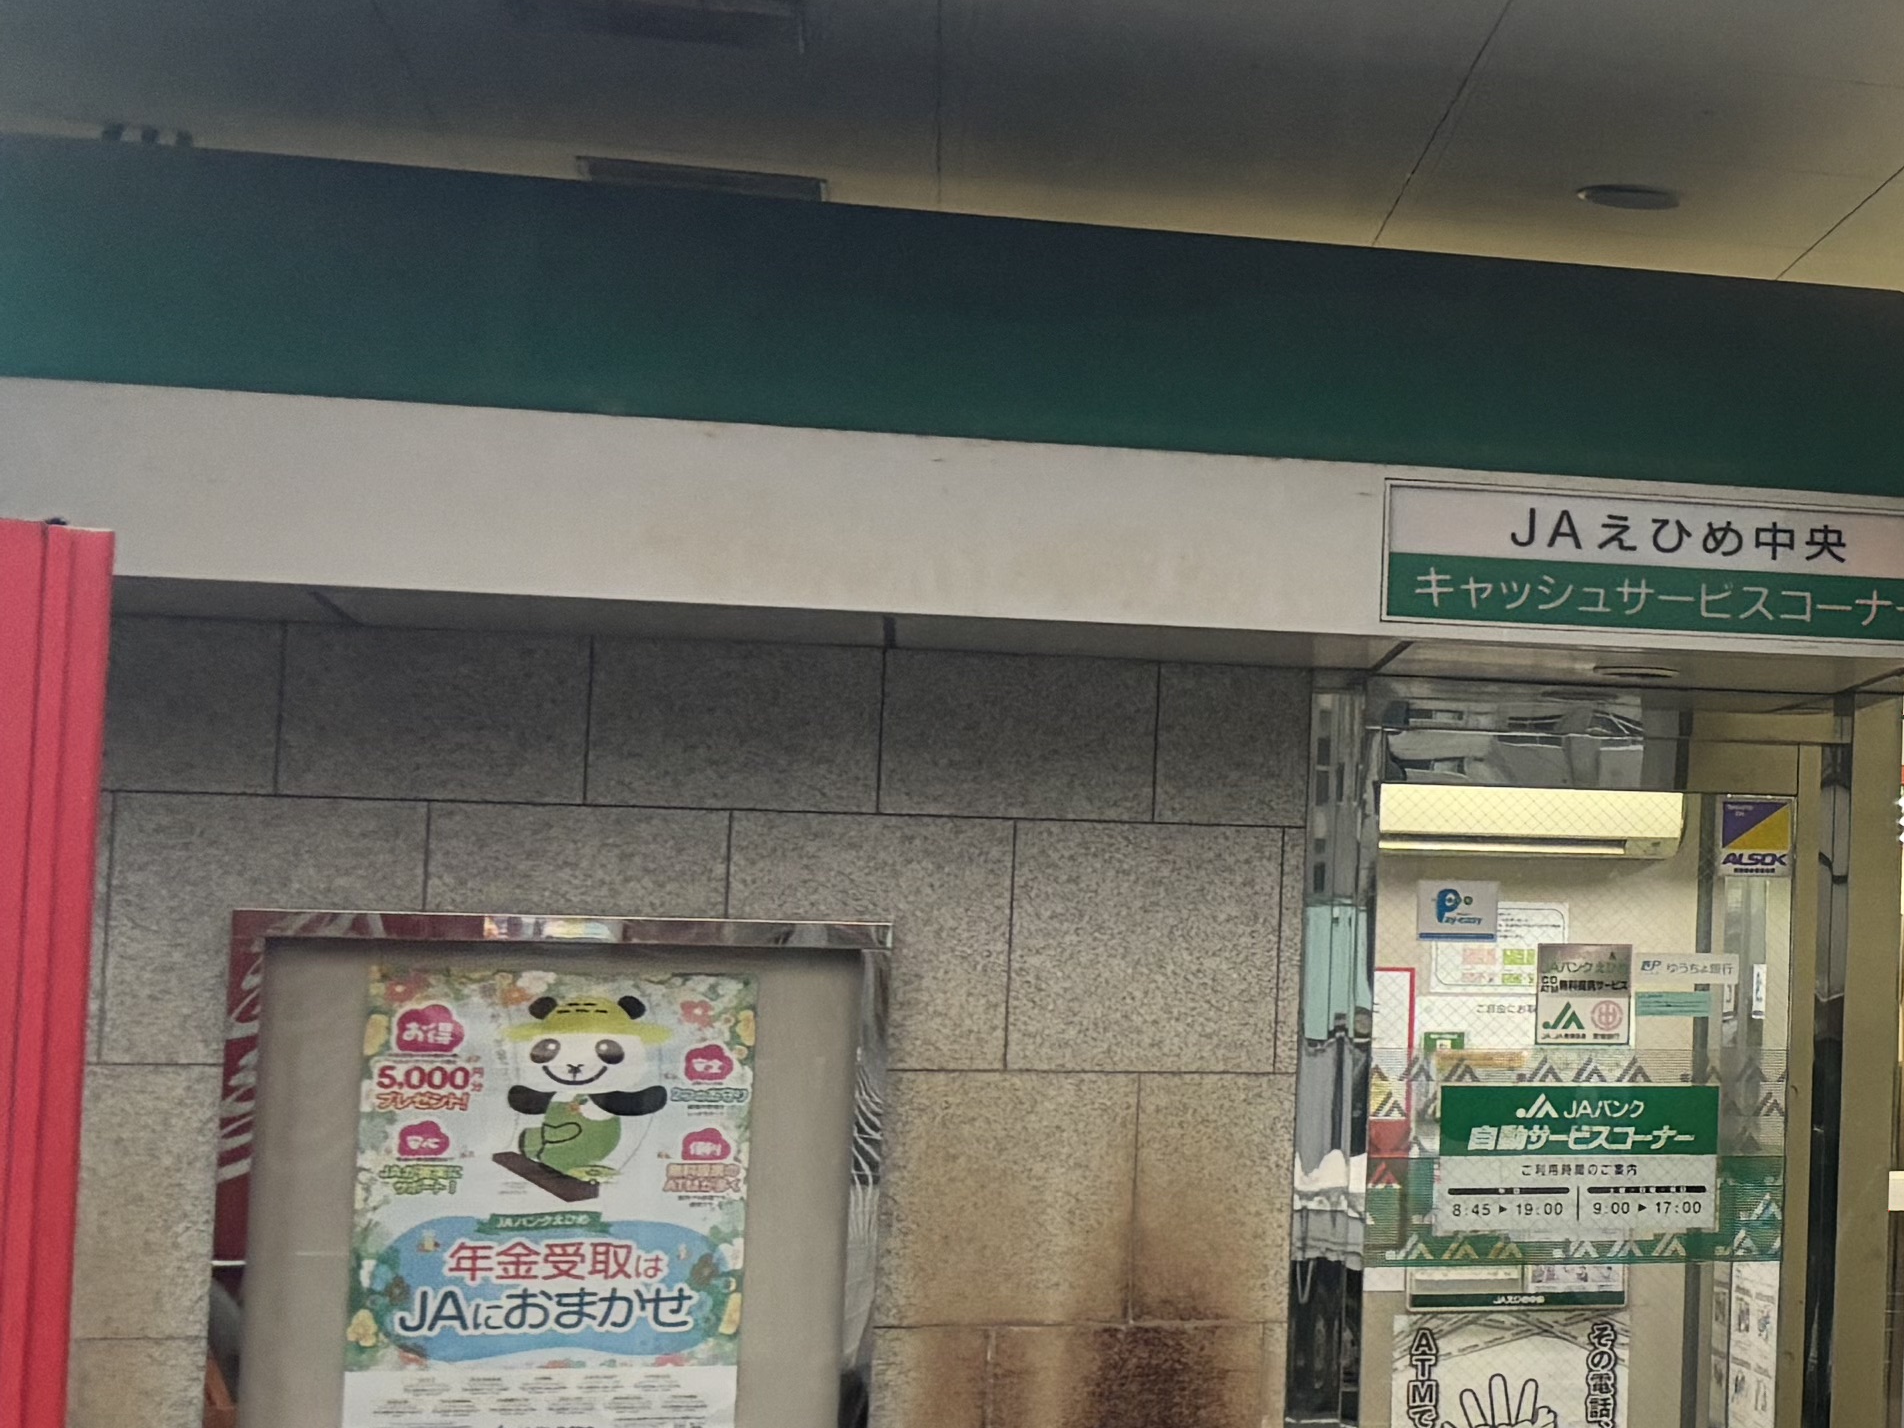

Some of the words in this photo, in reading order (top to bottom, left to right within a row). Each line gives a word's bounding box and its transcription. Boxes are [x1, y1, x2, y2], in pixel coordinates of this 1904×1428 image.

[1510, 506, 1847, 564] JAえひめ中央
[1564, 1099, 1645, 1119] JAバンク
[1467, 1124, 1696, 1151] 自動サービスコーナー
[1520, 1163, 1639, 1177] ご利用時間のご案内
[1451, 1202, 1492, 1217] 8:45
[1515, 1201, 1564, 1216] 19:00
[1592, 1200, 1631, 1215] 9:00
[1654, 1200, 1703, 1215] 17:00
[448, 1240, 665, 1282] 年金受取は
[399, 1286, 694, 1333] JAにおまかせ
